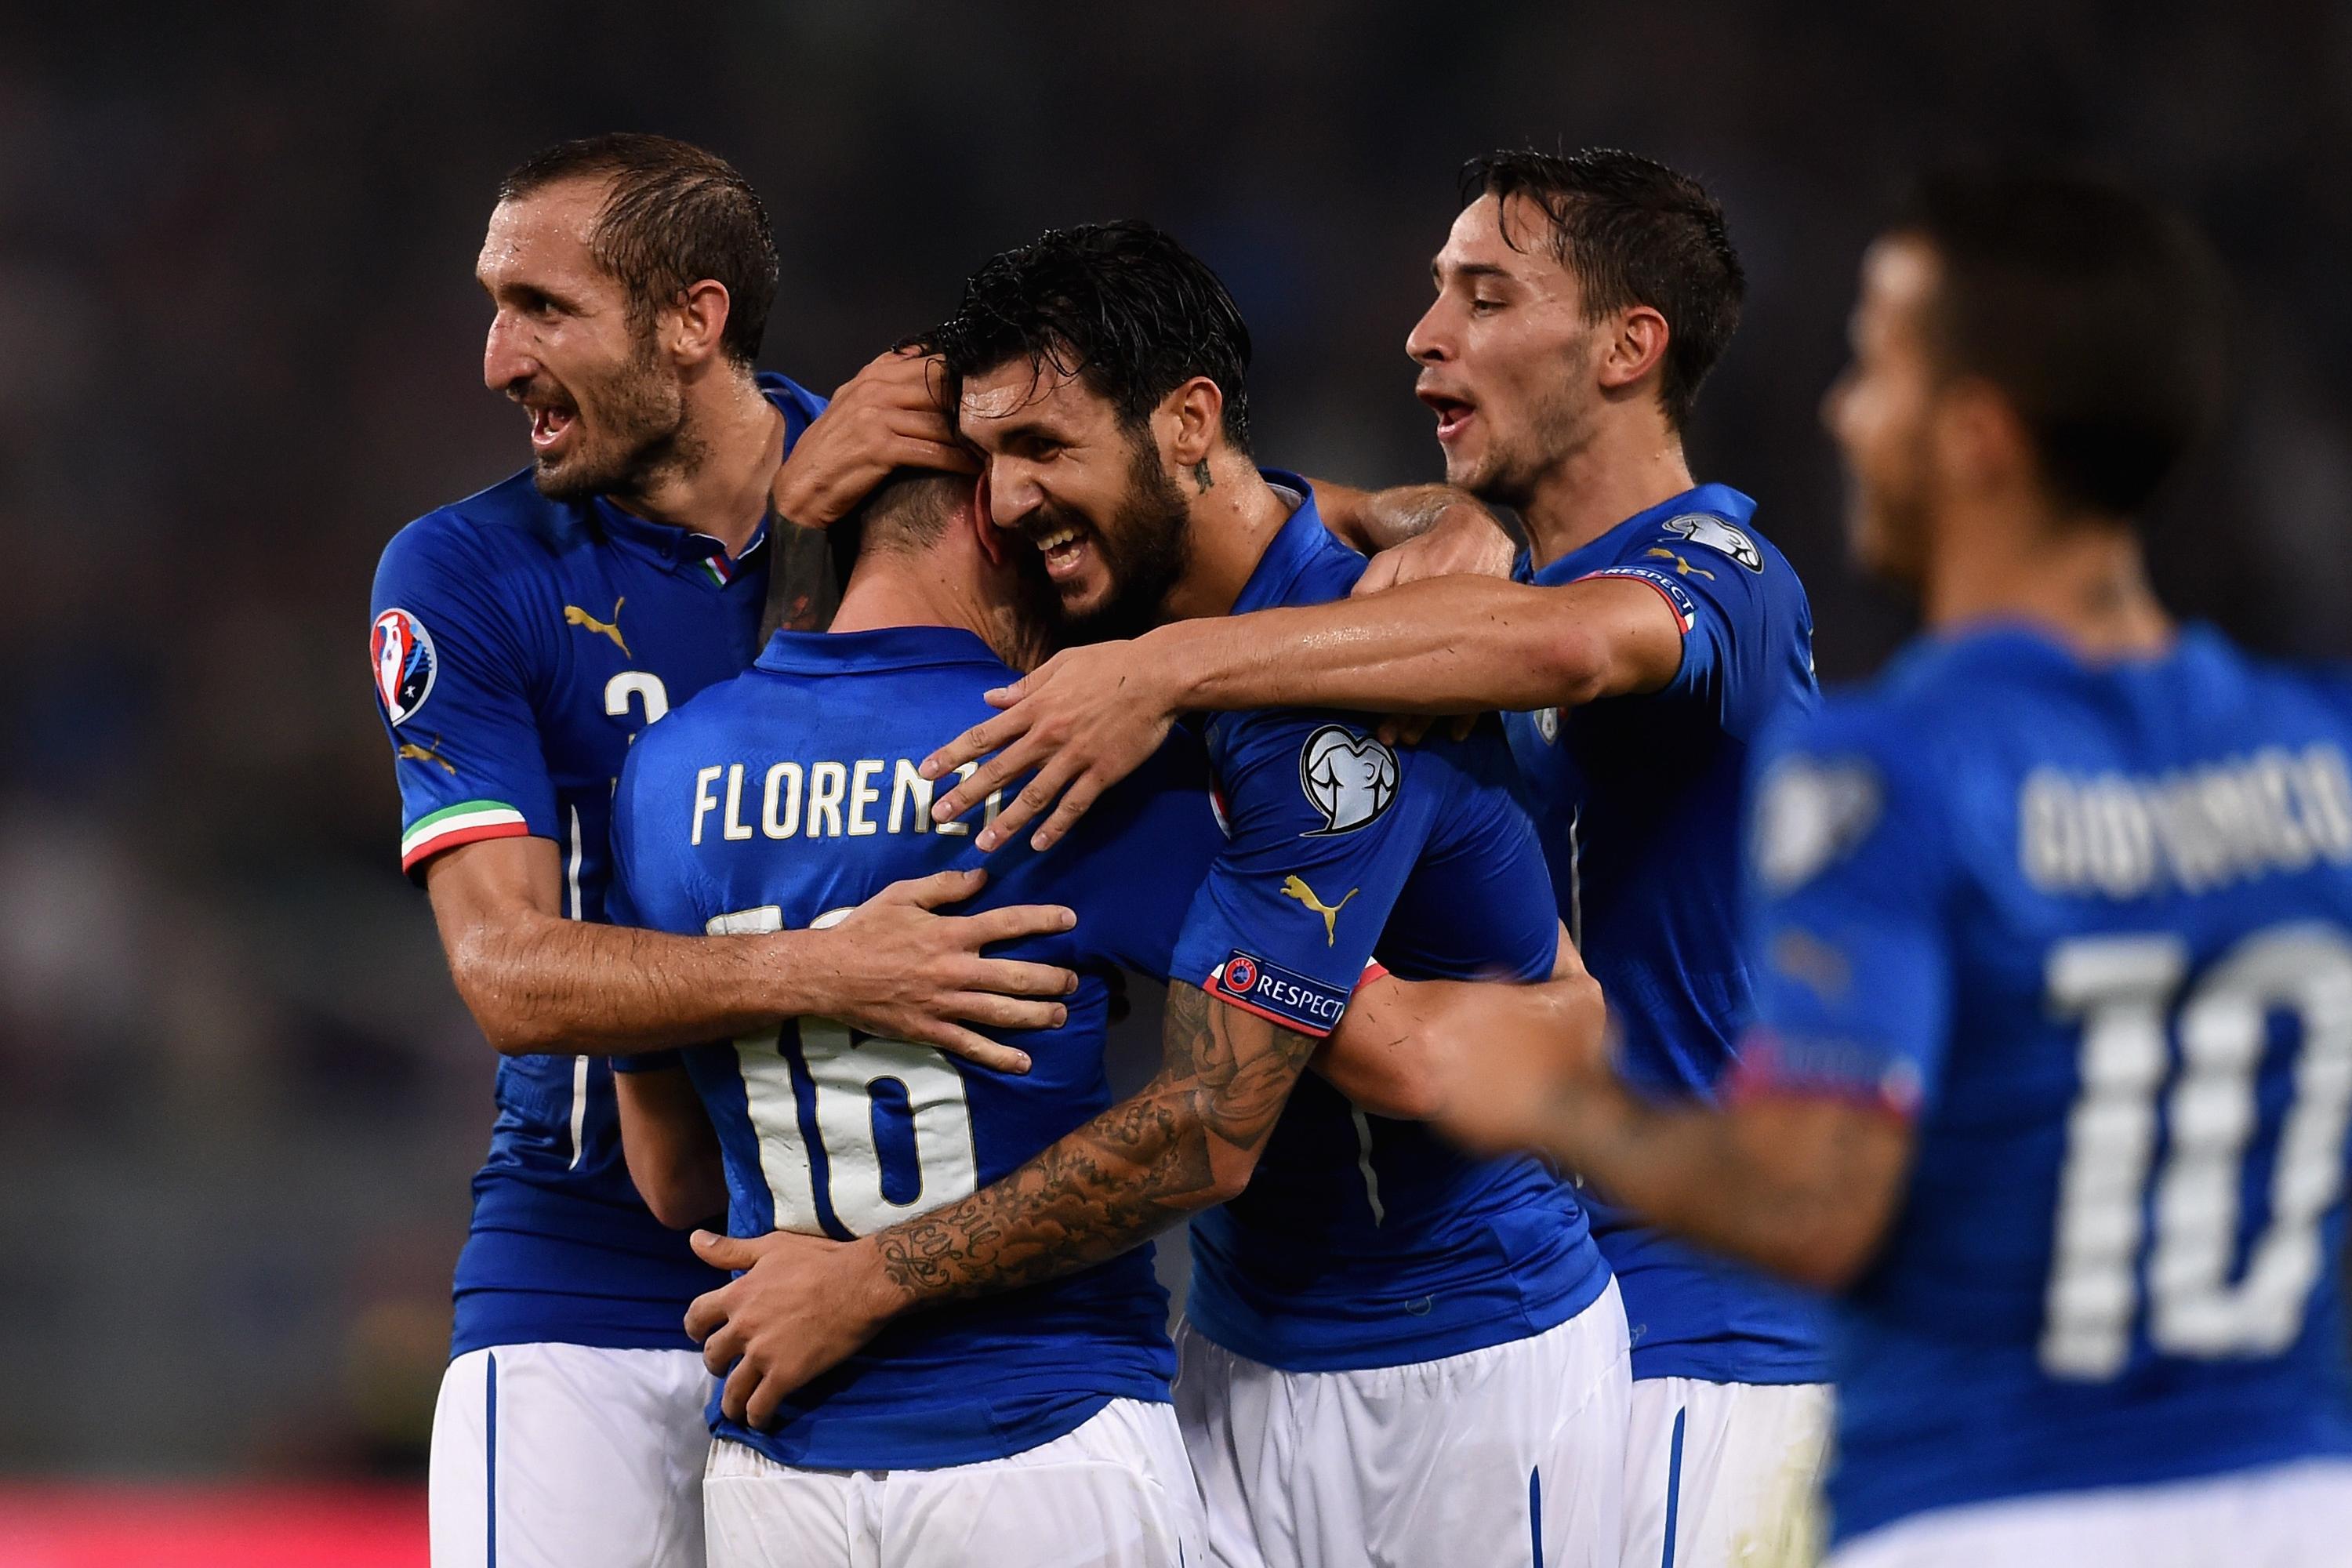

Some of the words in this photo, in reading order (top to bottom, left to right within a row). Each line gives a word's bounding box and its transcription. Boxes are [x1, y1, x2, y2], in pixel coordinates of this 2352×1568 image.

[1604, 568, 1695, 610] RESPECT
[1235, 960, 1253, 971] UEFA
[1257, 975, 1344, 1018] RESPECT
[706, 906, 978, 1239] 16
[2042, 924, 2352, 1379] 10
